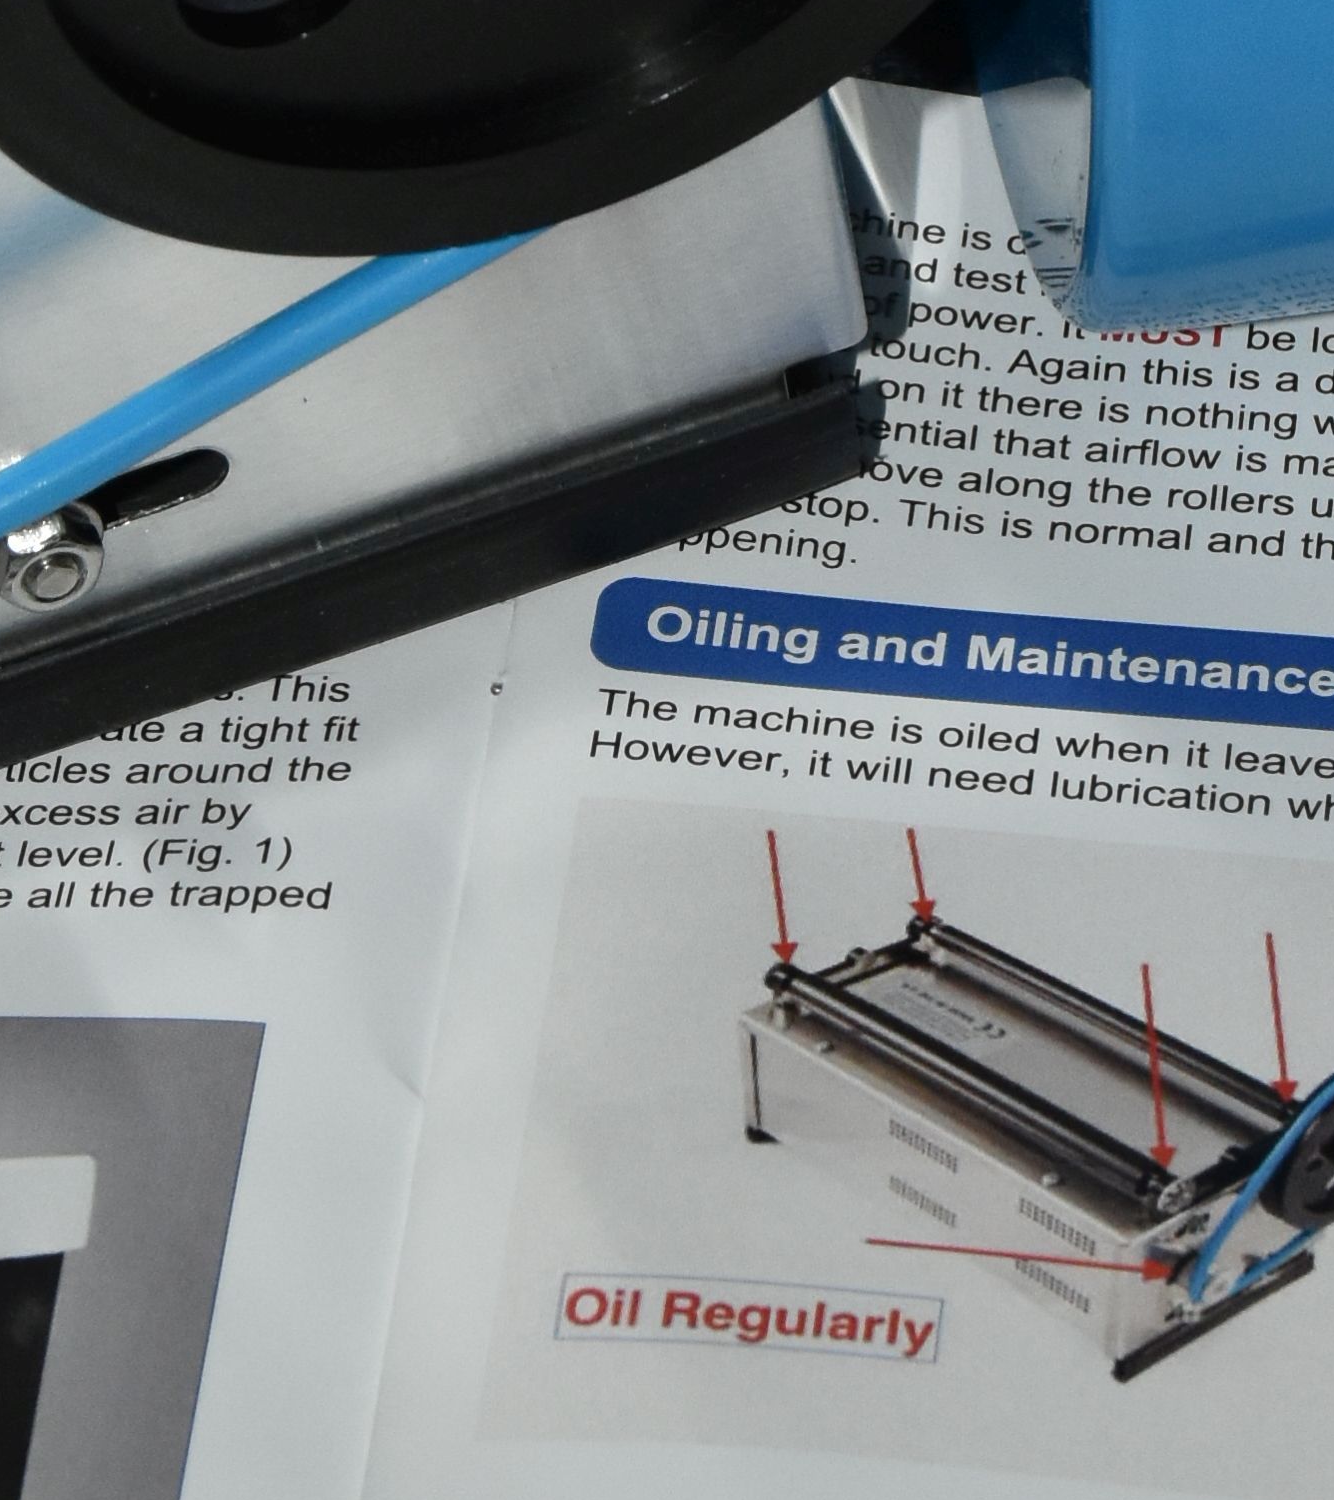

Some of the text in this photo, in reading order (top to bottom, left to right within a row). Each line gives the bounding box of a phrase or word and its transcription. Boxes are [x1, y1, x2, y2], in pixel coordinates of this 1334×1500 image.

[646, 603, 821, 666] Oiling
[836, 630, 949, 669] and
[598, 687, 679, 723] The
[692, 703, 876, 741] machine
[889, 714, 924, 746] is
[937, 722, 1041, 756] oiled
[1054, 731, 1170, 766] when
[1185, 741, 1211, 770] it
[564, 1286, 936, 1360] Oil Regularly
